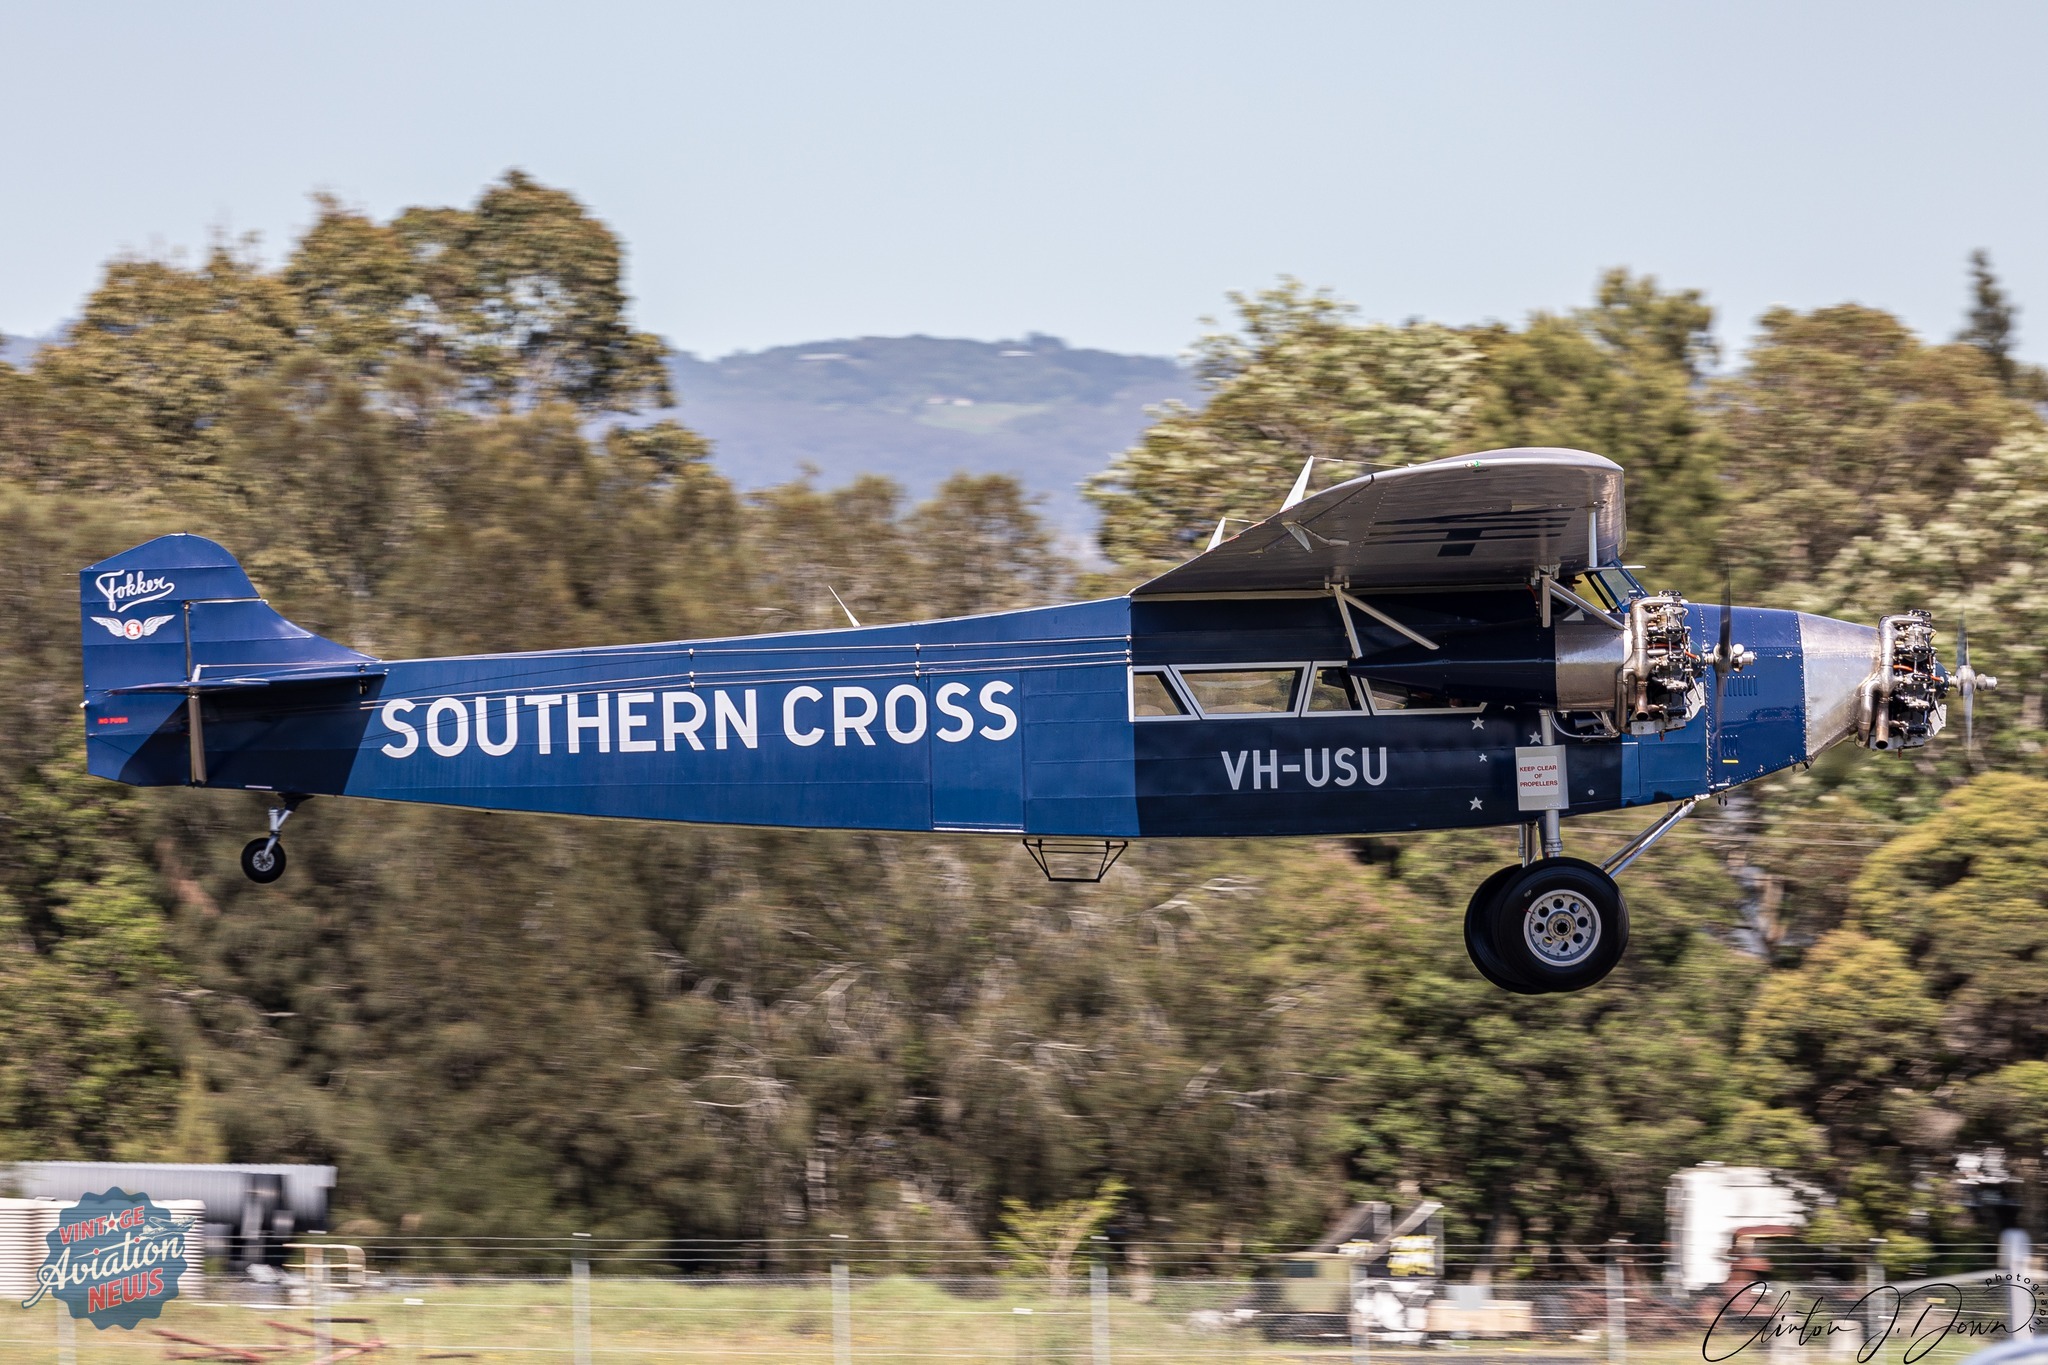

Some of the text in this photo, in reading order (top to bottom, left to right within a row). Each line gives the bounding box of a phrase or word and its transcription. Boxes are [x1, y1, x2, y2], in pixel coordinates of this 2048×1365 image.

[95, 569, 175, 612] Fokker
[380, 680, 1019, 759] SOUTHERN CROSS
[1220, 746, 1388, 791] VH-USU
